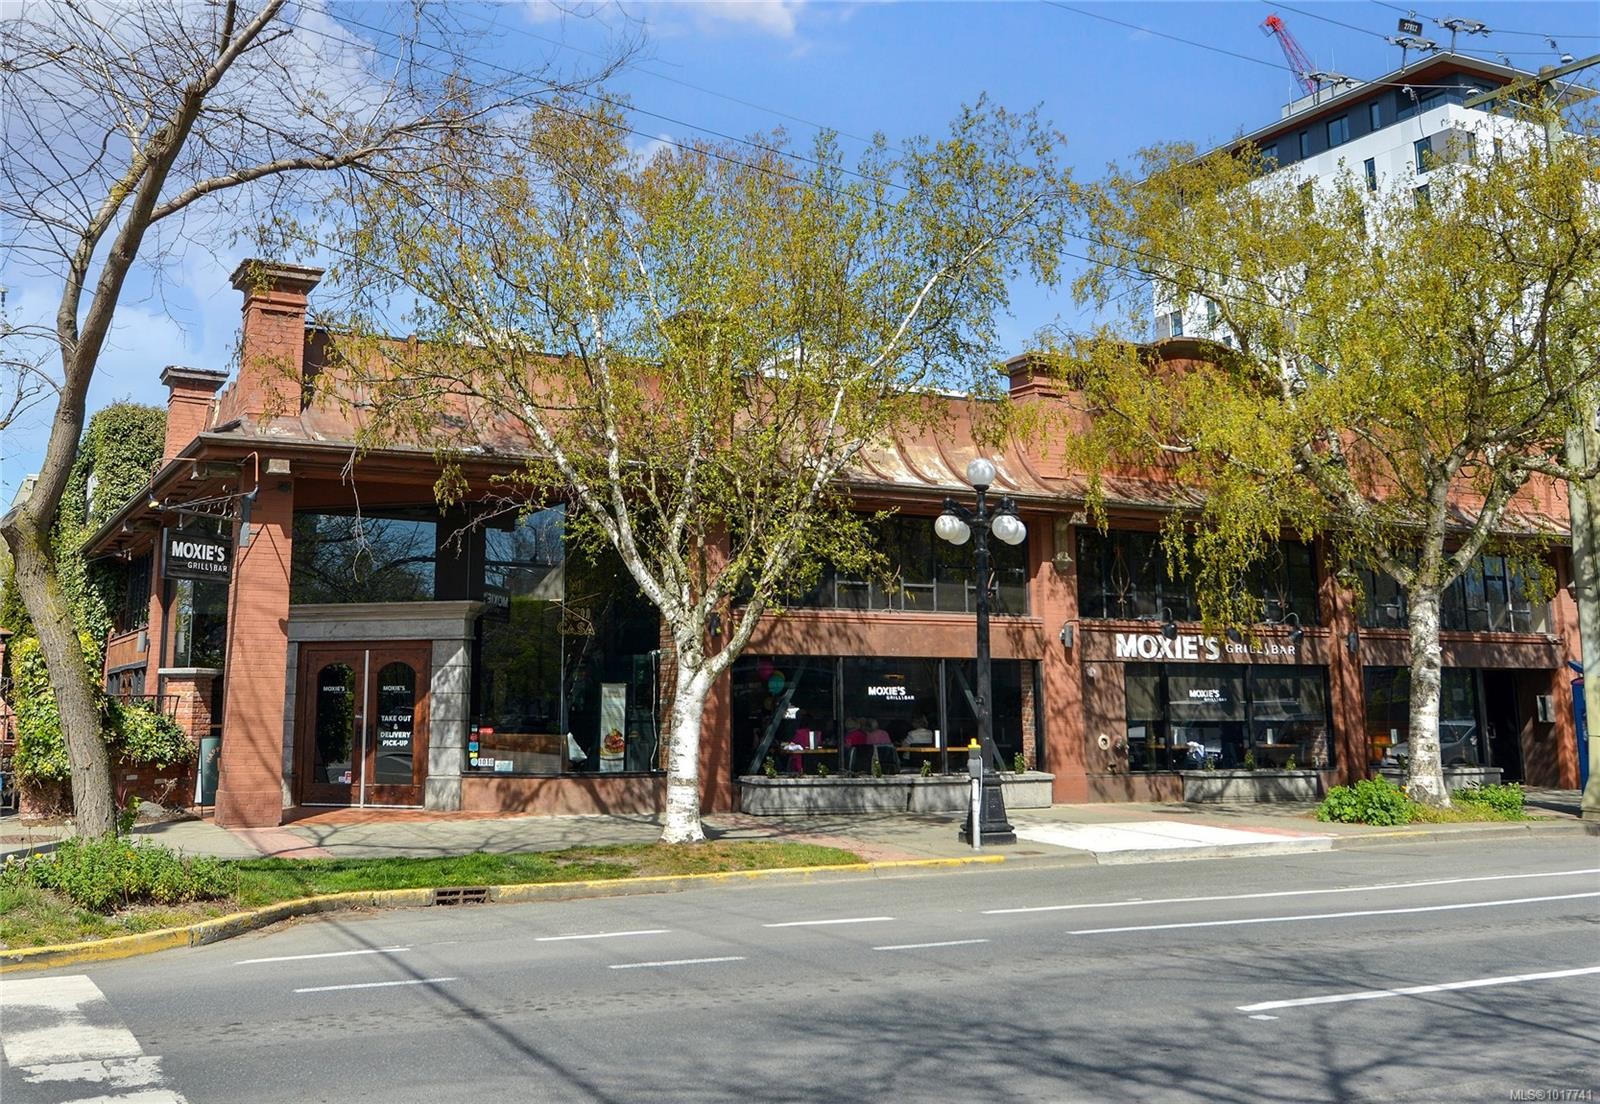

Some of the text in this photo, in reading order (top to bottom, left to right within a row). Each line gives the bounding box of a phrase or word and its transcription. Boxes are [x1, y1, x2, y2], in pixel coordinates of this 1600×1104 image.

[172, 541, 225, 562] MOXIE'S
[1115, 633, 1220, 661] MOXIE'S
[868, 686, 906, 696] MOXIE'S
[1189, 689, 1220, 698] MOXIE'S
